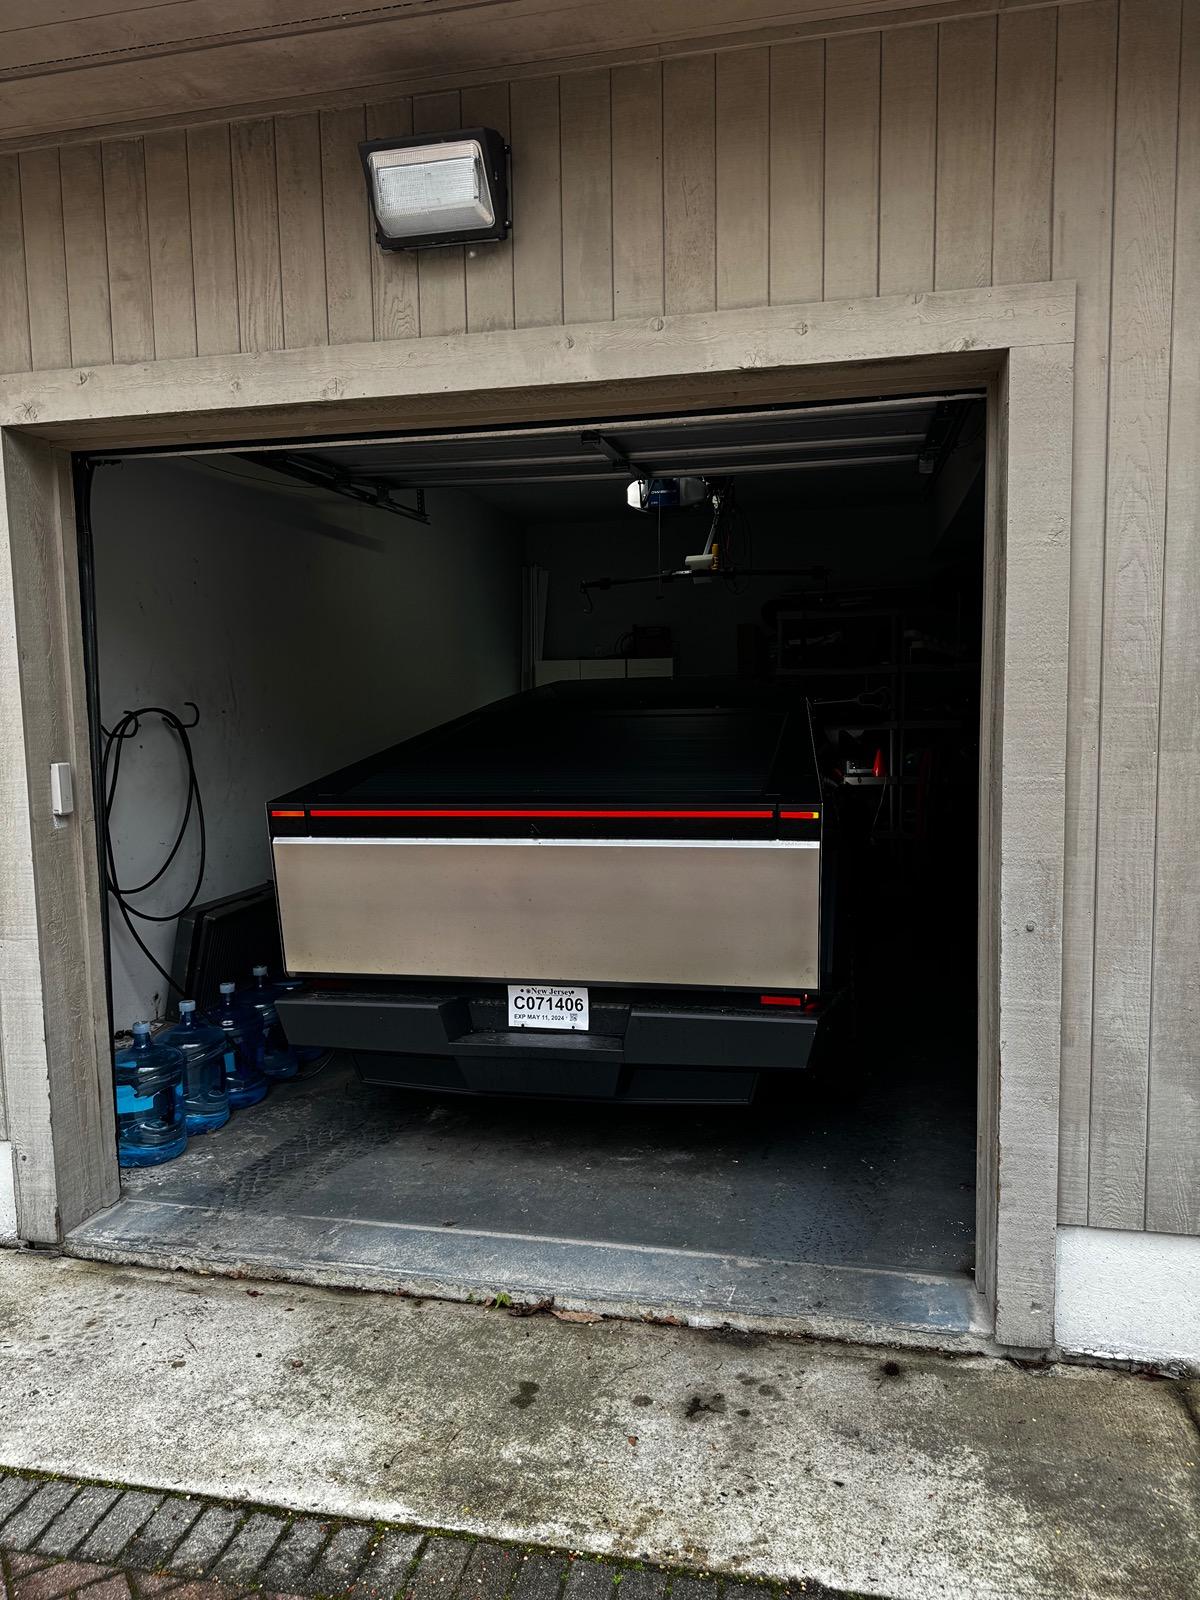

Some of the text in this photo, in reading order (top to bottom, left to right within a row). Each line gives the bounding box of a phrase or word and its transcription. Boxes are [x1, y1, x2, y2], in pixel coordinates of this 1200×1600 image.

[531, 987, 572, 997] New Jersey
[514, 996, 584, 1011] C071406
